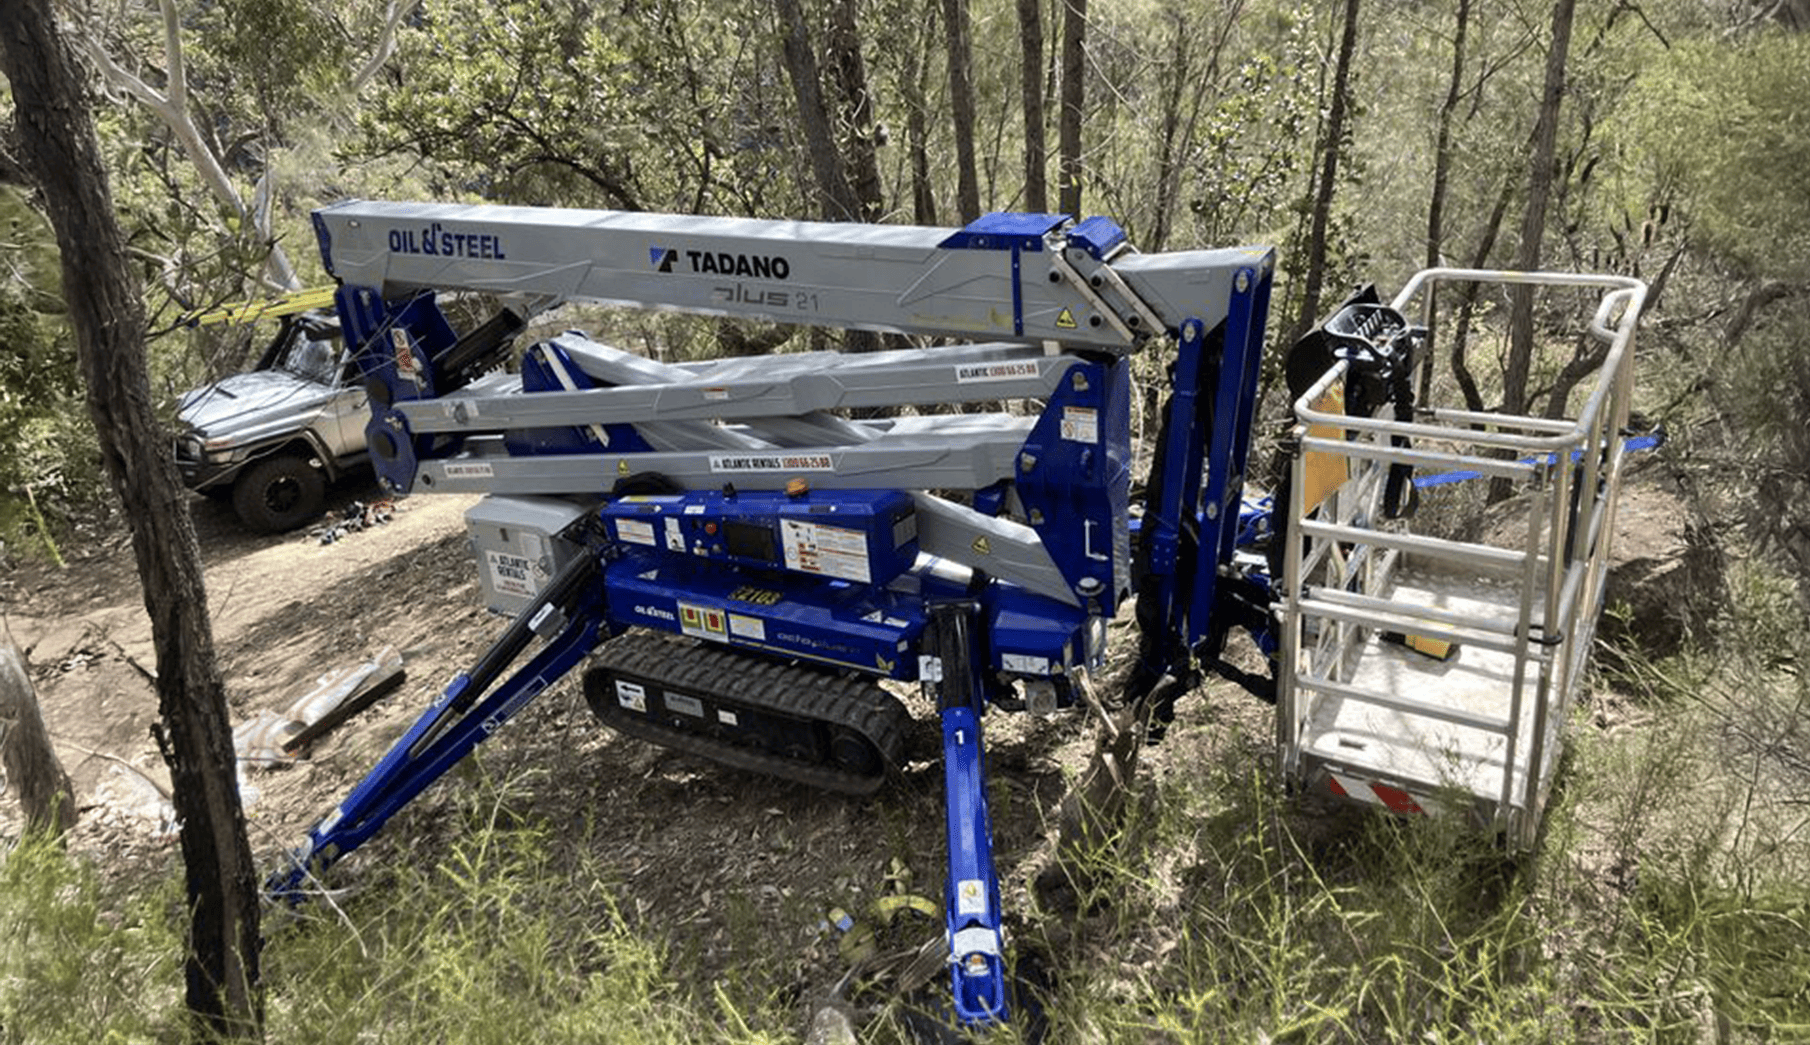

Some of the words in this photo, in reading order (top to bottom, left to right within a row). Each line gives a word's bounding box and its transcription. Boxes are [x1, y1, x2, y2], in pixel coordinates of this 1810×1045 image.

[687, 250, 790, 279] TADANO
[795, 292, 818, 312] 21
[960, 368, 988, 378] ATLANTIC
[722, 459, 751, 469] ATLANTIC
[752, 458, 780, 468] RENTALS
[499, 555, 529, 571] ATLANTIC
[498, 565, 526, 580] RENTALS
[955, 730, 964, 744] 1
